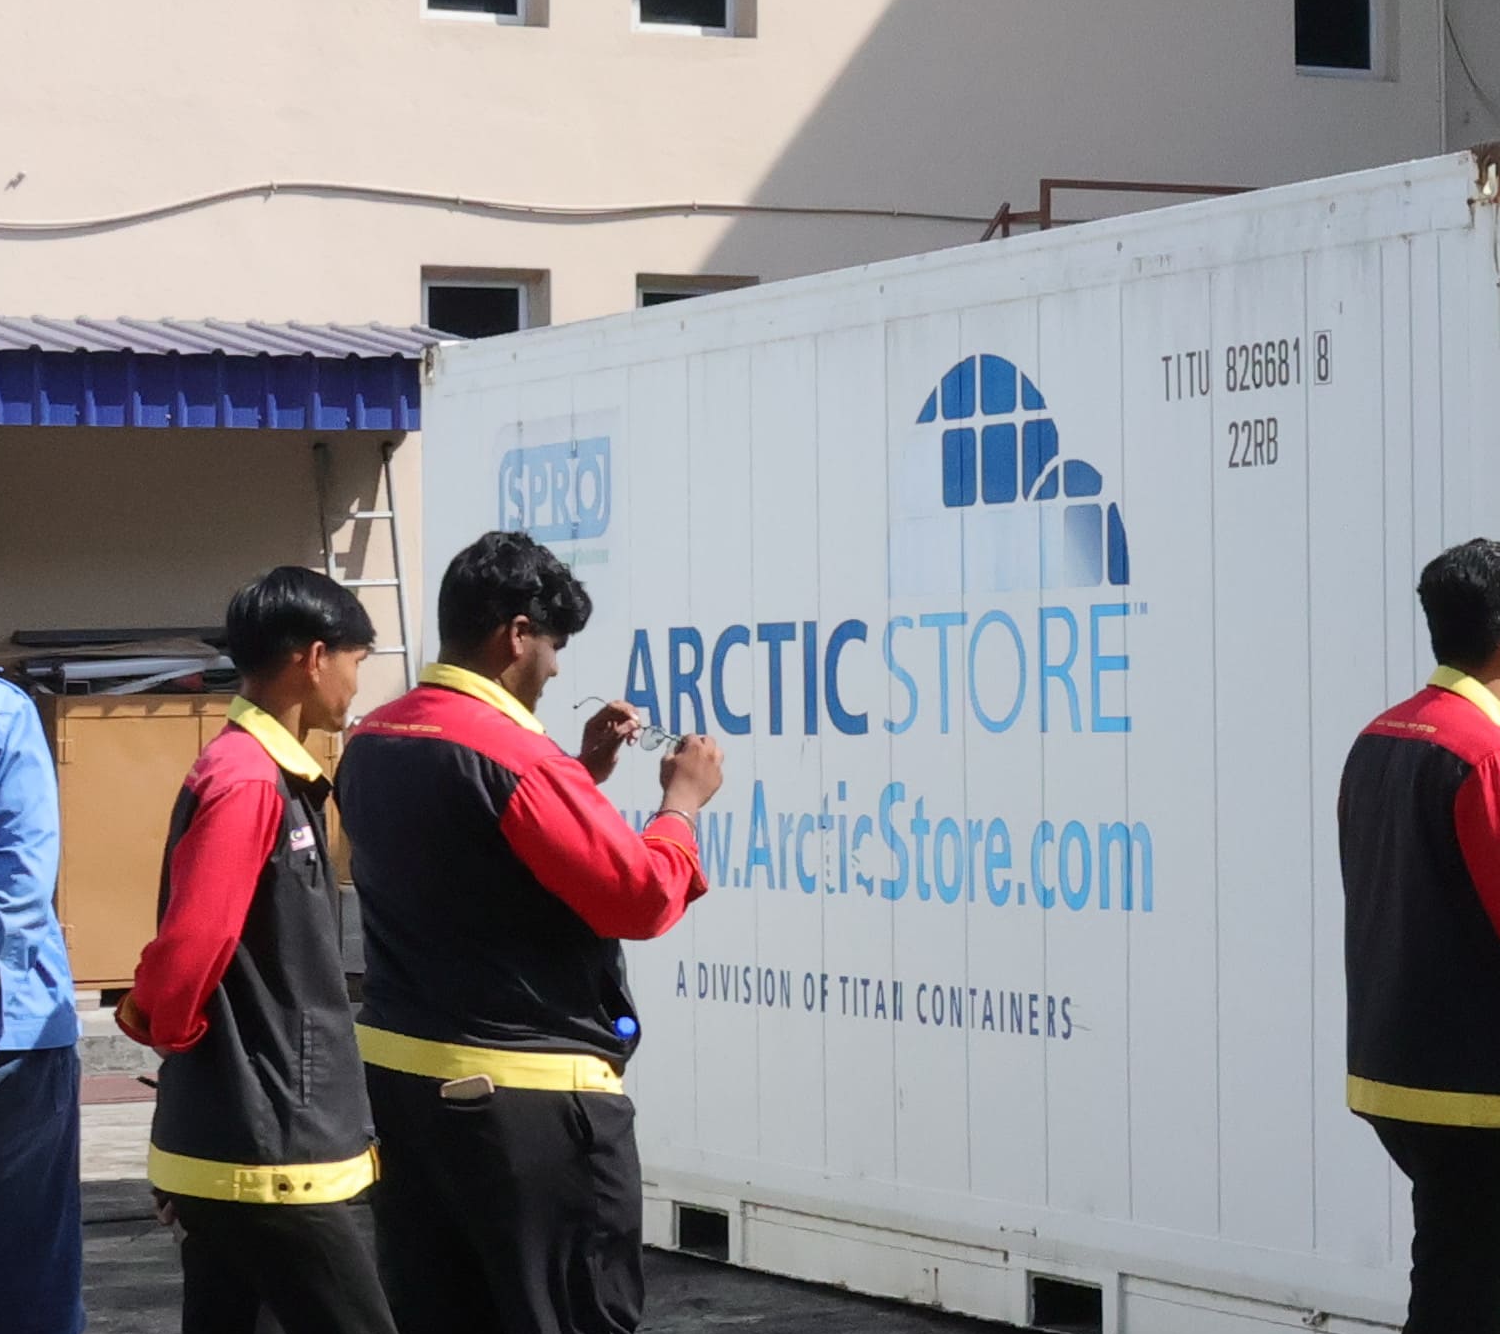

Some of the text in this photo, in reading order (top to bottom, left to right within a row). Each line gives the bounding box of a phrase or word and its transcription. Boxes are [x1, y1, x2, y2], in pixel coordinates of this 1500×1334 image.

[1161, 334, 1329, 401] TITU 826681 8
[1228, 417, 1278, 468] 22RB
[504, 452, 606, 534] SPRO
[676, 962, 1073, 1040] A DIVISION OF TITAN CONTAINERS
